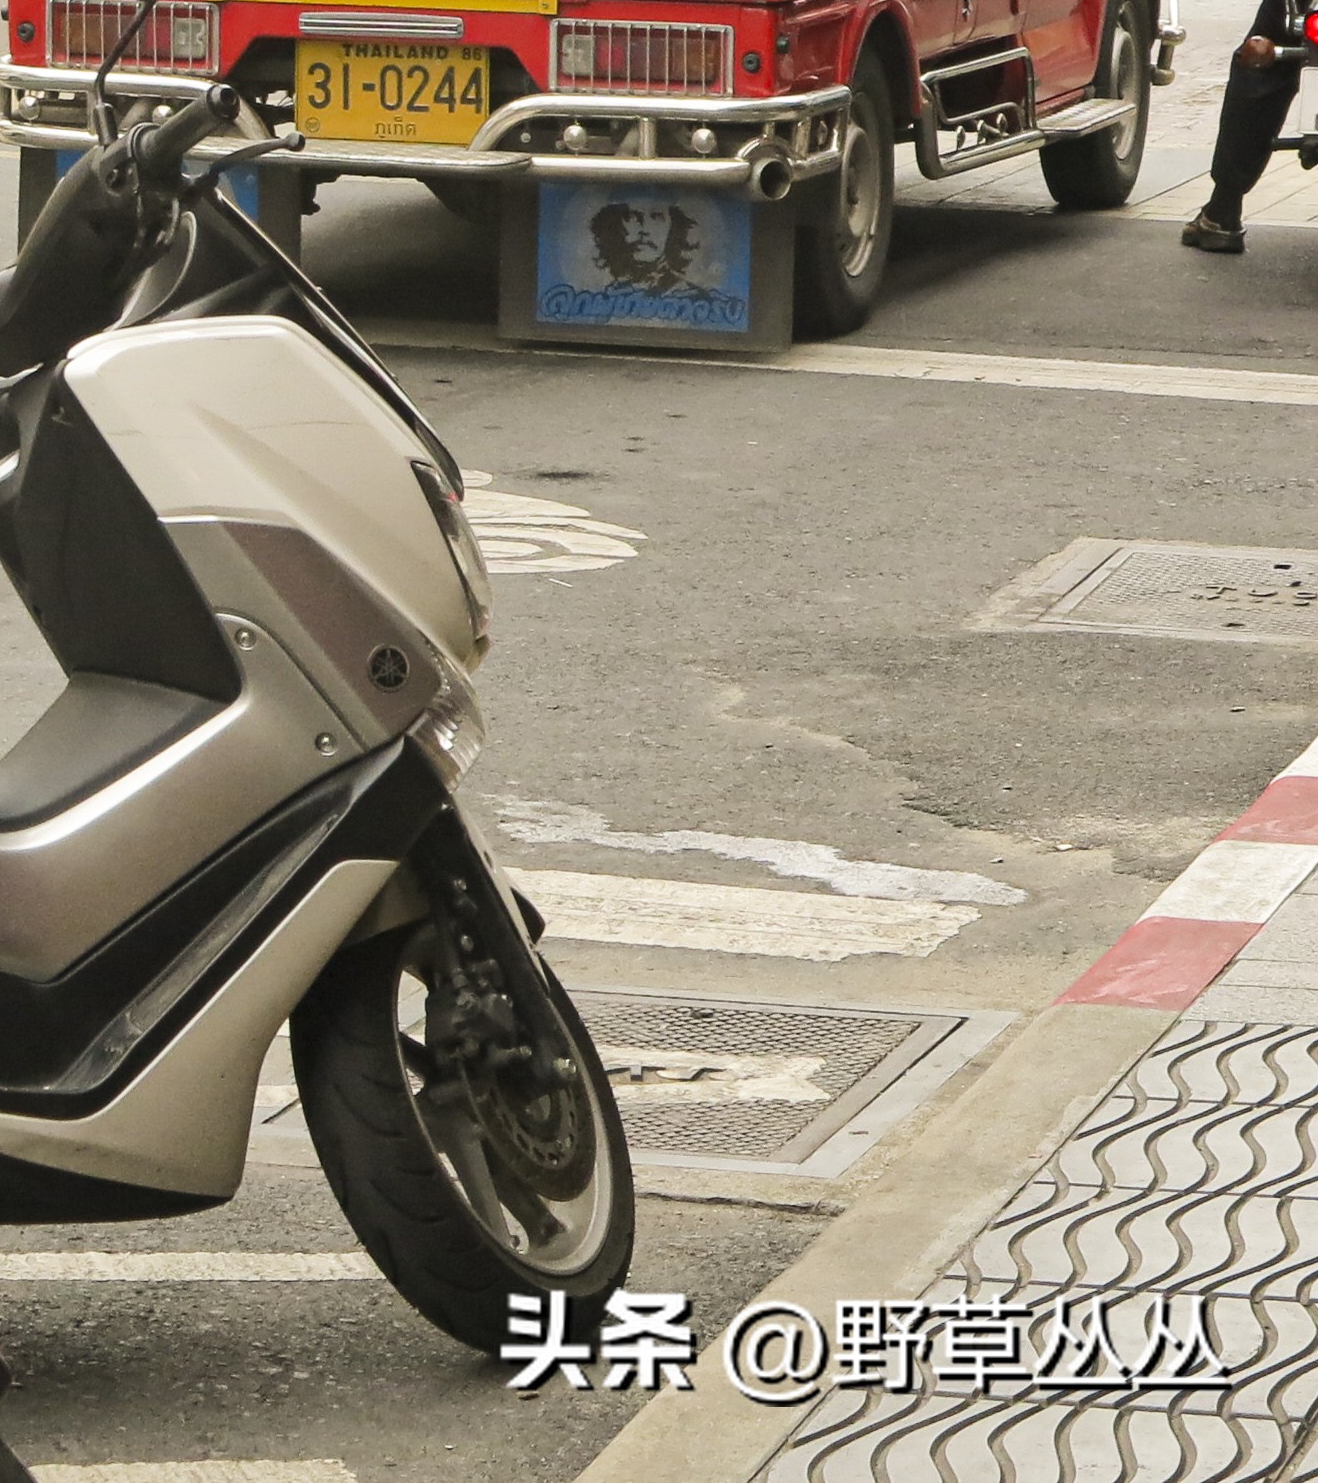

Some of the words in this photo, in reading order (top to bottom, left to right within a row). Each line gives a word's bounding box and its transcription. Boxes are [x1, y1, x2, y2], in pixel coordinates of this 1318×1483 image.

[342, 43, 448, 61] THAILAND
[308, 62, 483, 114] 31-0244
[374, 117, 417, 138] ภูเก็ต
